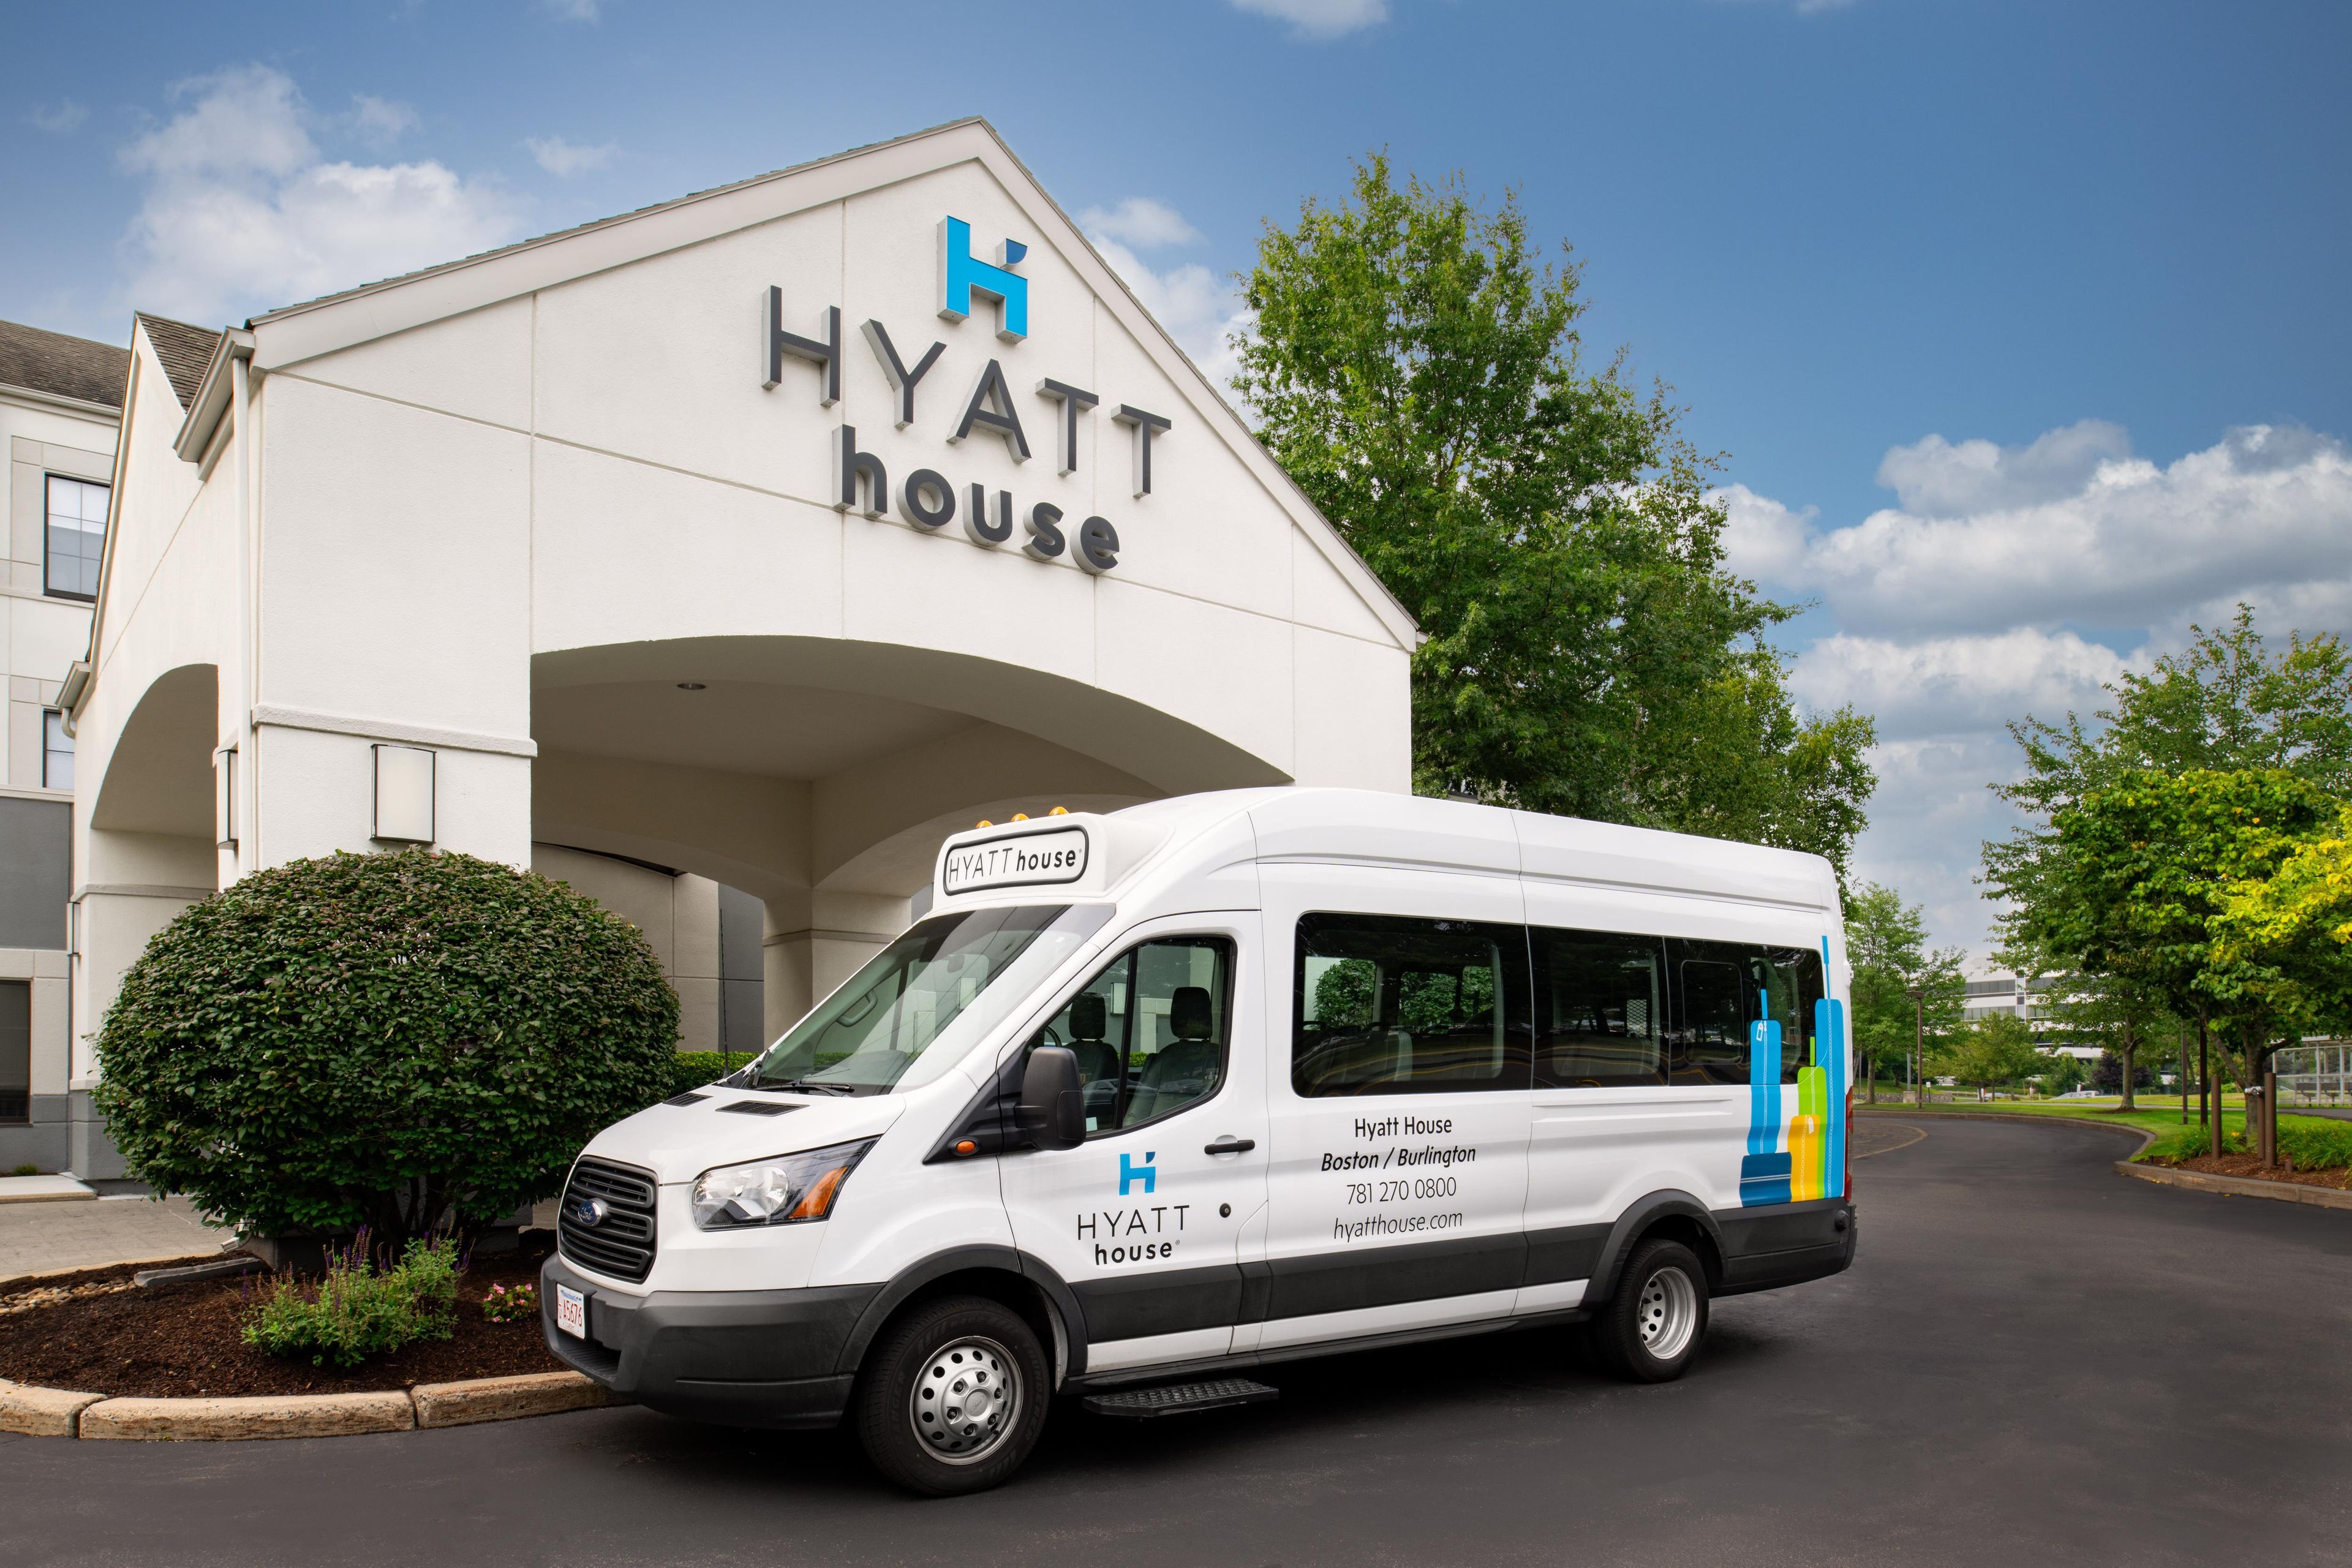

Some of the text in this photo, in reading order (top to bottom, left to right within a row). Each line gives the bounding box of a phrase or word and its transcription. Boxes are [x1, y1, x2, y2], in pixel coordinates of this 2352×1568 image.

[762, 285, 1172, 499] HYATT
[832, 424, 1120, 575] house
[949, 847, 1013, 883] HYATT
[1355, 1116, 1452, 1141] Hyatt House
[1321, 1151, 1379, 1171] Boston
[1397, 1145, 1476, 1168] Burlington
[1346, 1177, 1457, 1205] 781 270 0800
[1078, 1205, 1190, 1240] HYATT
[1334, 1213, 1463, 1243] hyatthouse.com
